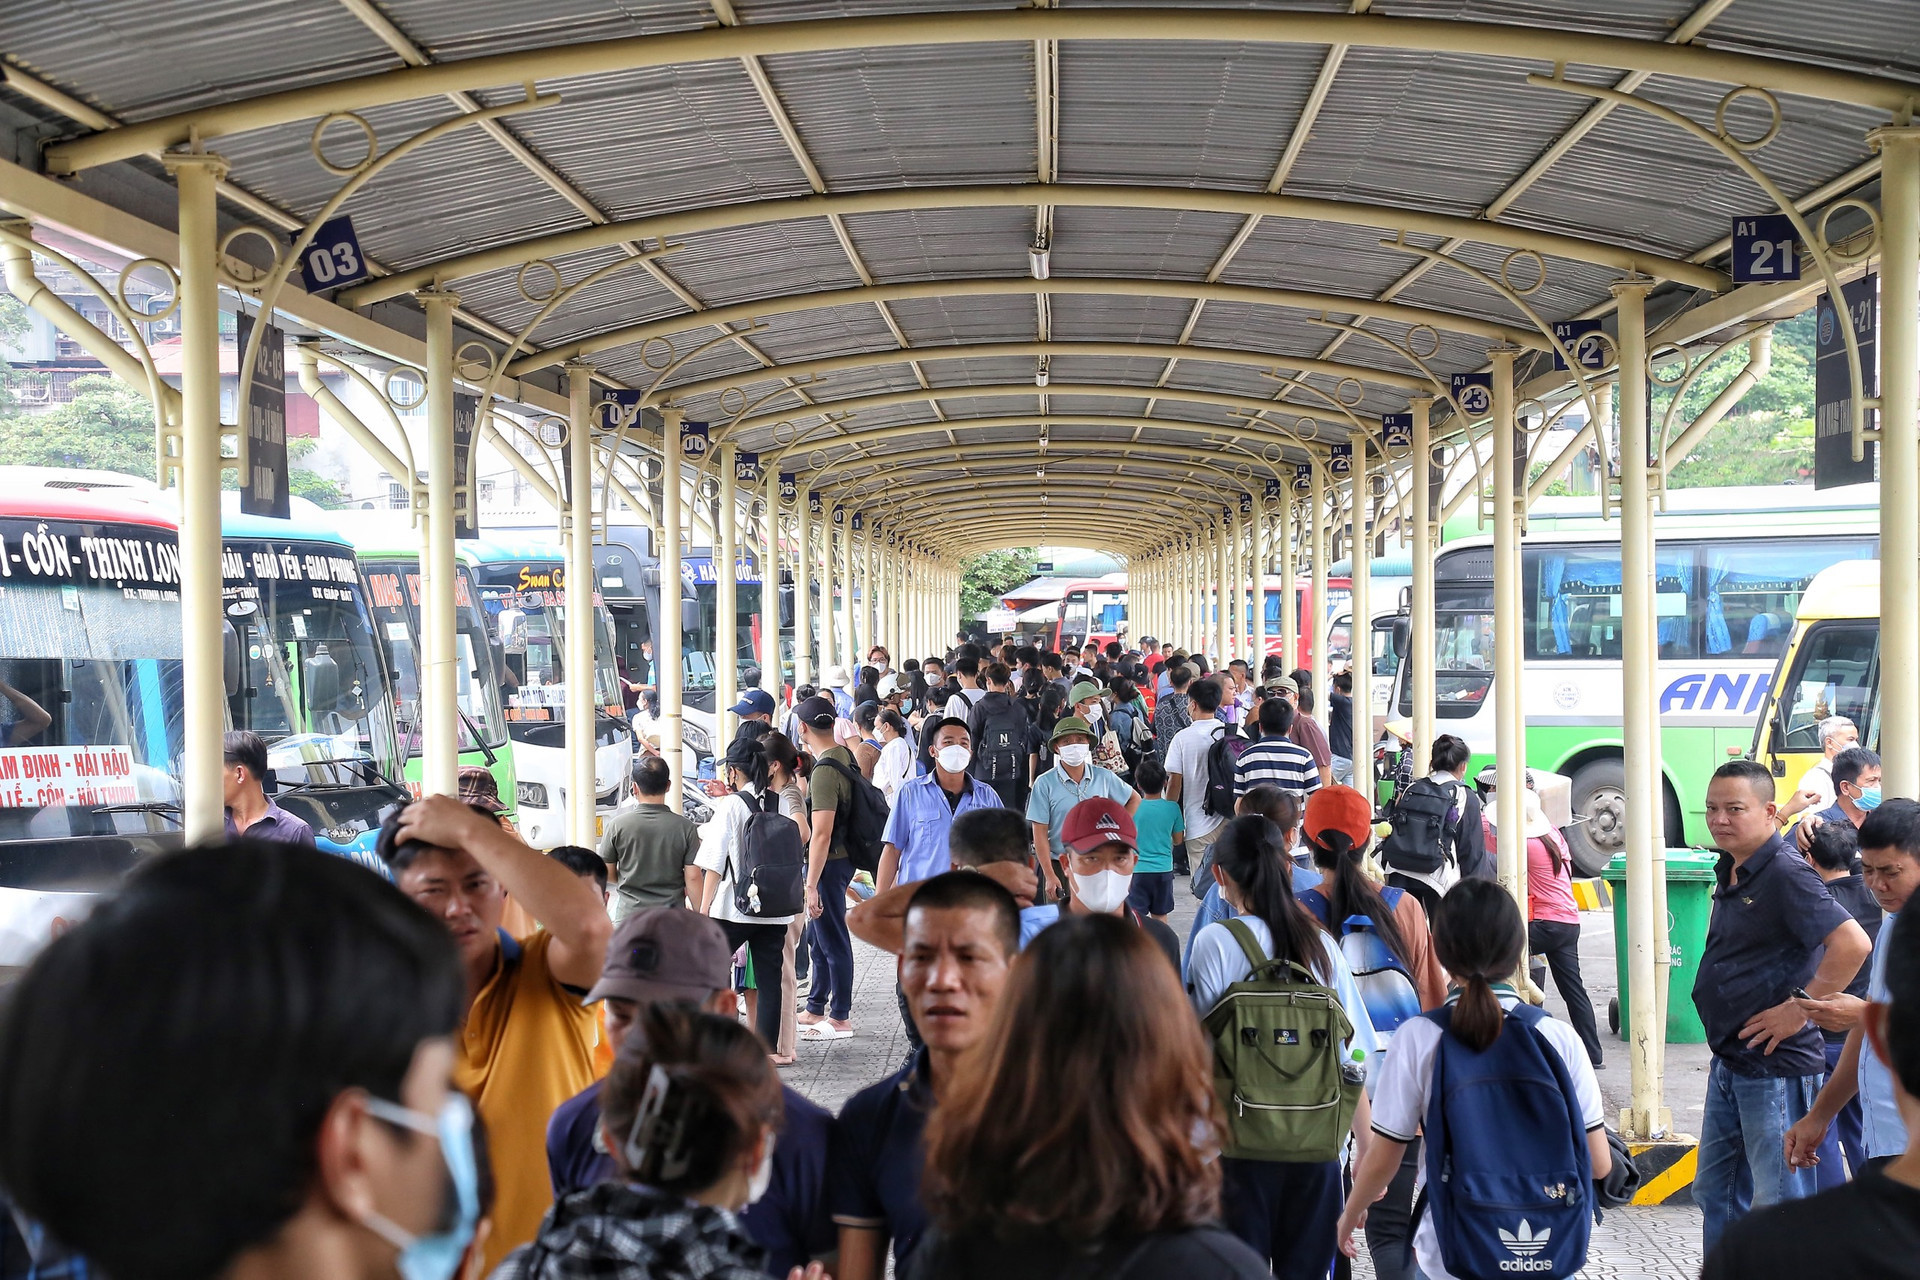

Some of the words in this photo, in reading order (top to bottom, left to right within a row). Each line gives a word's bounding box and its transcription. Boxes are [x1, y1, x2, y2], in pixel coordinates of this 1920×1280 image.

[1737, 221, 1756, 236] A1
[309, 241, 359, 282] 03
[1750, 240, 1793, 275] 21
[1556, 325, 1571, 336] A1
[1454, 376, 1466, 385] A1
[605, 392, 618, 401] A2
[1458, 388, 1488, 409] 23
[609, 404, 637, 425] 05
[1384, 416, 1395, 424] A1
[680, 424, 690, 432] A2
[1301, 474, 1310, 486] 2
[1244, 500, 1251, 511] 2
[854, 518, 859, 528] 1
[80, 536, 149, 588] THỊNH
[145, 541, 181, 584] LON
[252, 552, 280, 579] GIAO
[278, 546, 303, 580] YẾN
[305, 555, 330, 581] GIAO
[517, 566, 550, 591] Swan
[123, 587, 137, 600] BX:
[160, 589, 179, 602] LONG
[240, 582, 260, 599] THỦY
[312, 586, 323, 599] BX
[323, 585, 339, 600] GIÁP
[339, 586, 353, 601] BÁT
[368, 573, 403, 613] MẠC
[22, 753, 62, 782] ĐỊNH
[73, 745, 99, 777] HẢI
[101, 748, 130, 780] HẬU
[1500, 1258, 1553, 1272] adidas
